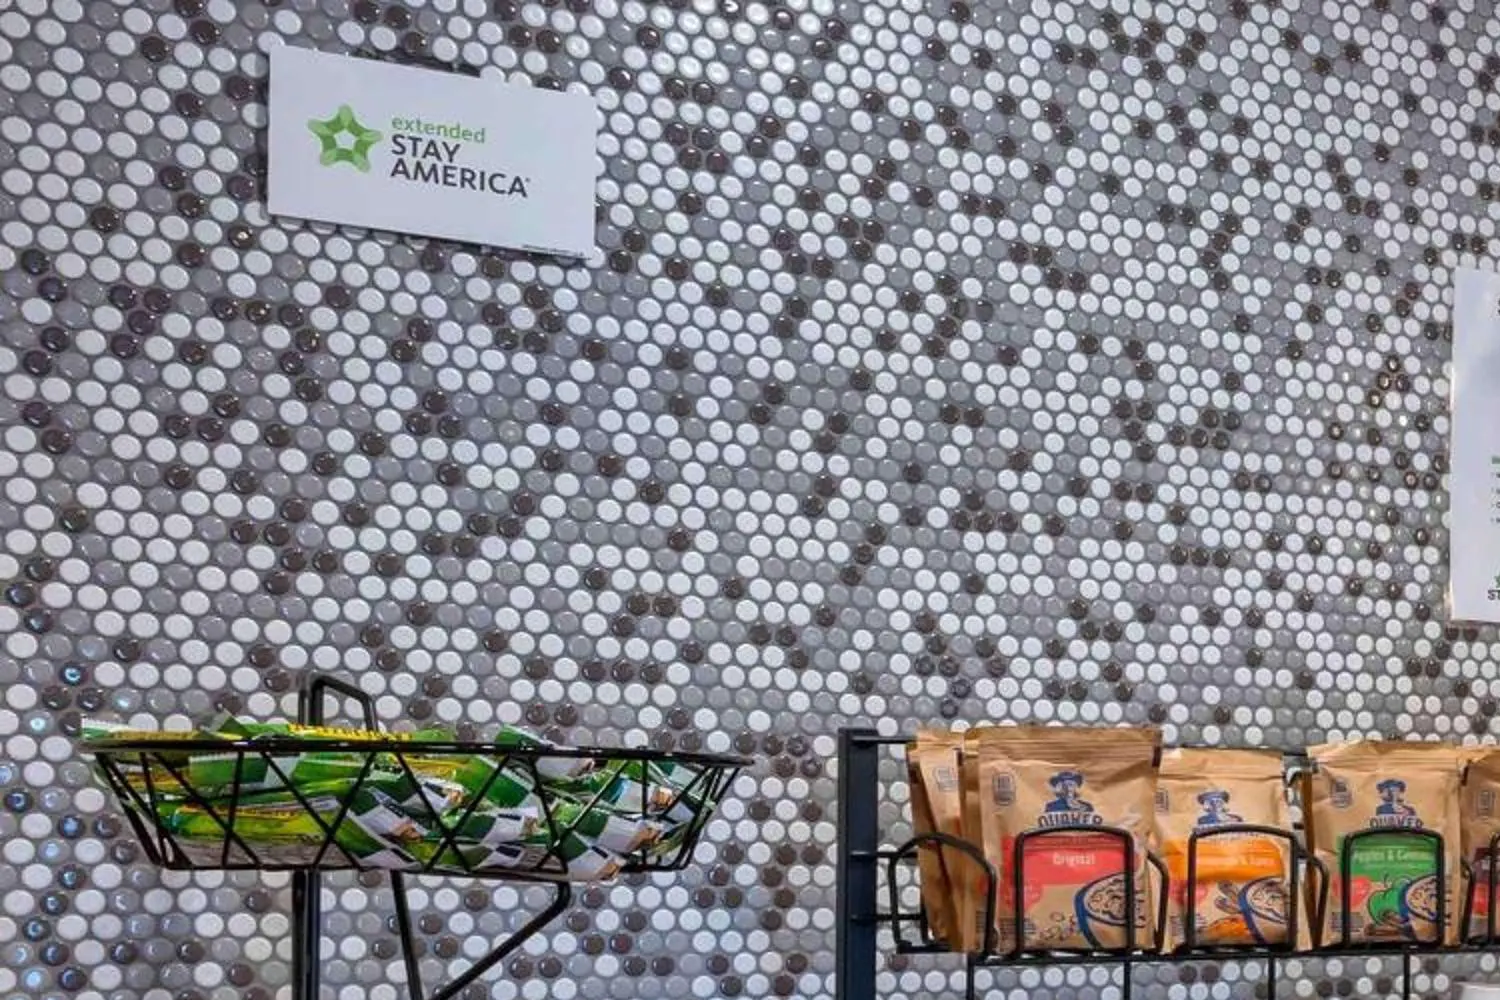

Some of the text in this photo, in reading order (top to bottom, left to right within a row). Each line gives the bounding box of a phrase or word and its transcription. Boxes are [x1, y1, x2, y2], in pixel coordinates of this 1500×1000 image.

[391, 117, 486, 144] extended
[391, 134, 461, 163] STAY
[390, 158, 529, 198] AMERICA
